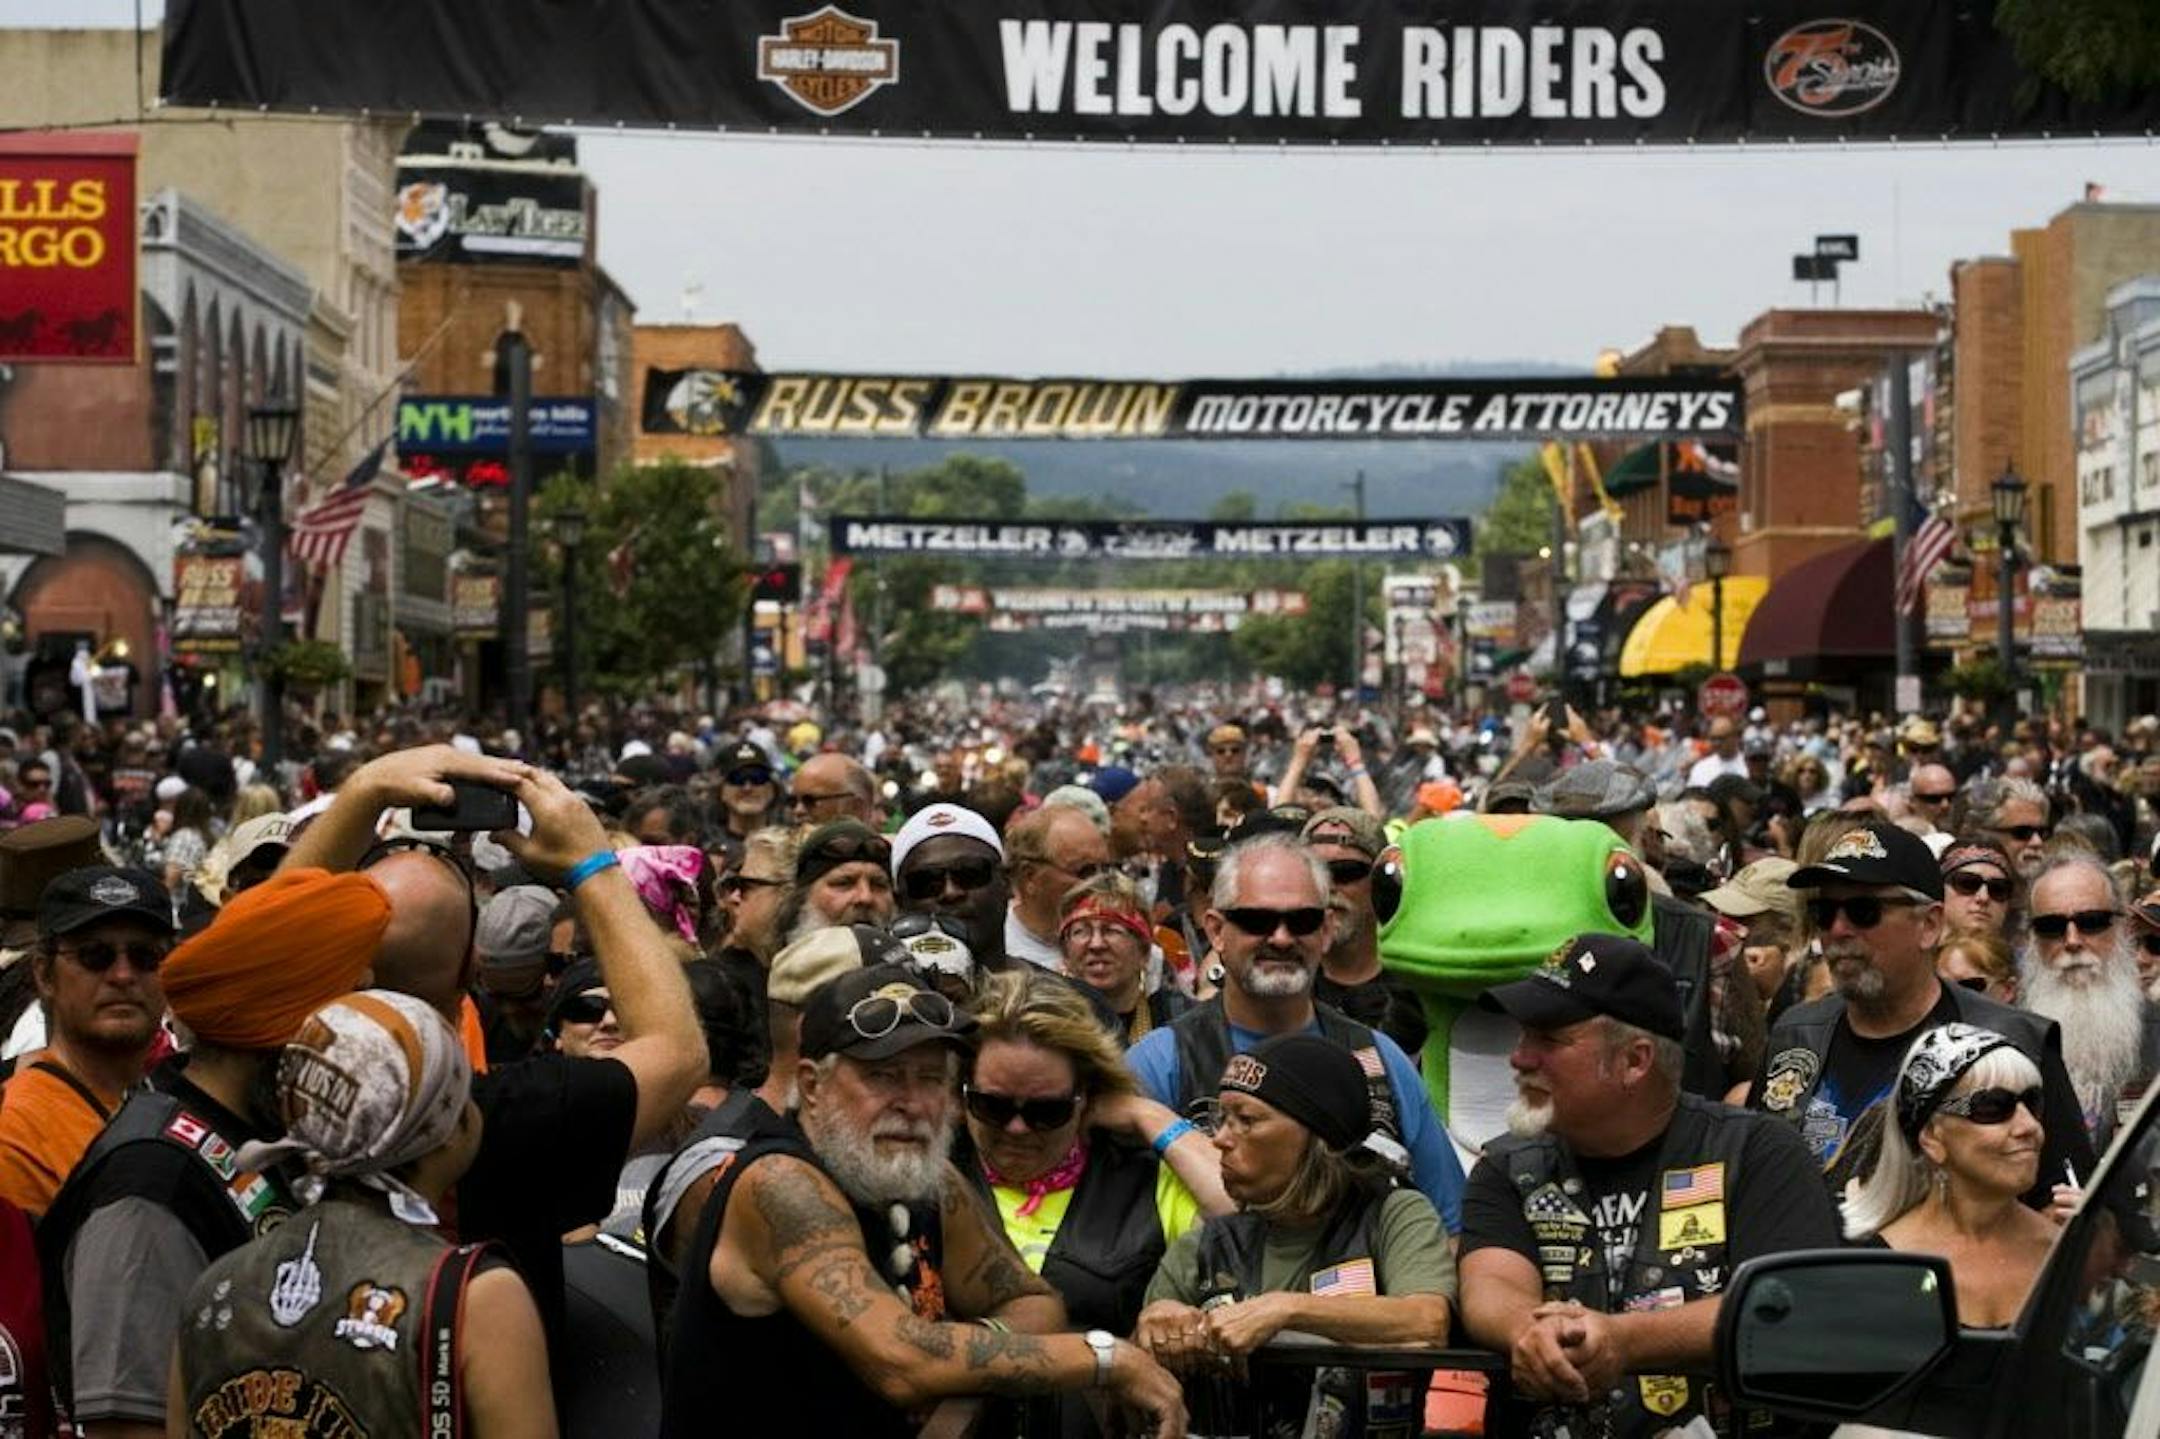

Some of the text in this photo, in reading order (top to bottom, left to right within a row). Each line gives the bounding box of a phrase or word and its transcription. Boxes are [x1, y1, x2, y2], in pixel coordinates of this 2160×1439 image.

[999, 20, 1666, 118] WELCOME RIDERS
[0, 180, 105, 219] LLS
[0, 226, 104, 267] RGO
[401, 403, 472, 442] NH
[750, 379, 1735, 434] RUSS BROWN MOTORCYCLE ATTORNEYS
[847, 523, 1053, 551] METZELER
[1214, 527, 1419, 551] METZELER
[438, 1342, 450, 1377] Mark
[432, 1380, 450, 1407] 5D
